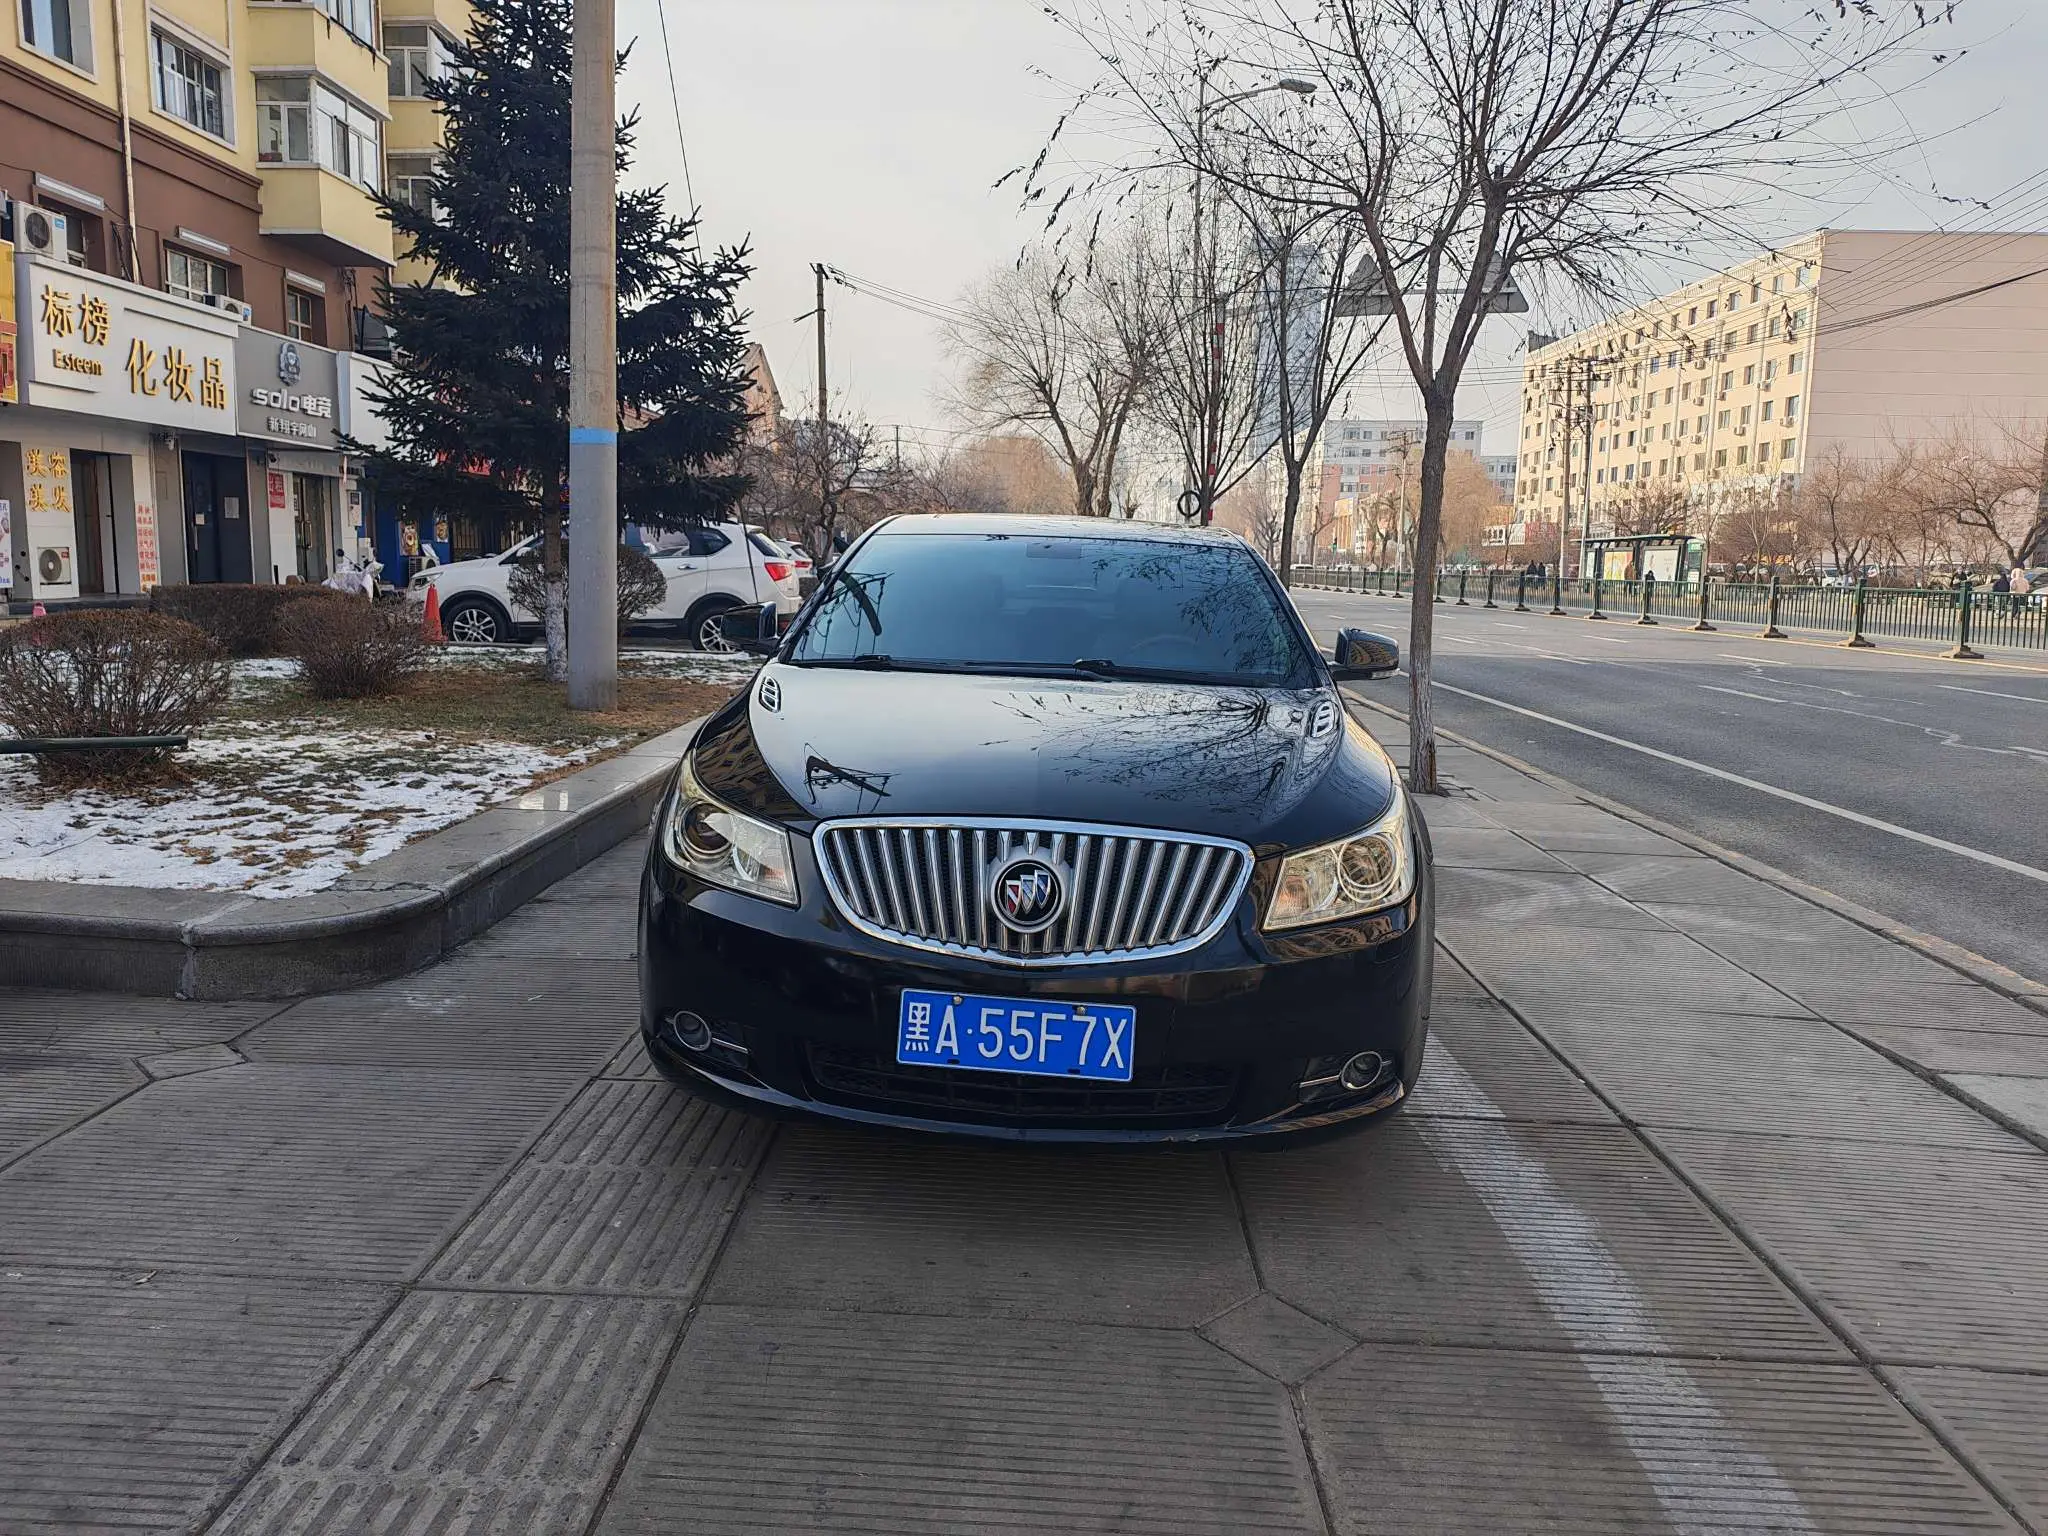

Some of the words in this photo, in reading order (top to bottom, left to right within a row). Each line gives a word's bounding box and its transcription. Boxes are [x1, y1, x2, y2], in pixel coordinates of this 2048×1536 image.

[41, 285, 111, 346] 标榜
[53, 349, 104, 377] Esteem
[125, 337, 229, 410] 化妆品
[25, 449, 67, 479] 美容
[904, 1002, 1128, 1069] 黑A·55F7X
